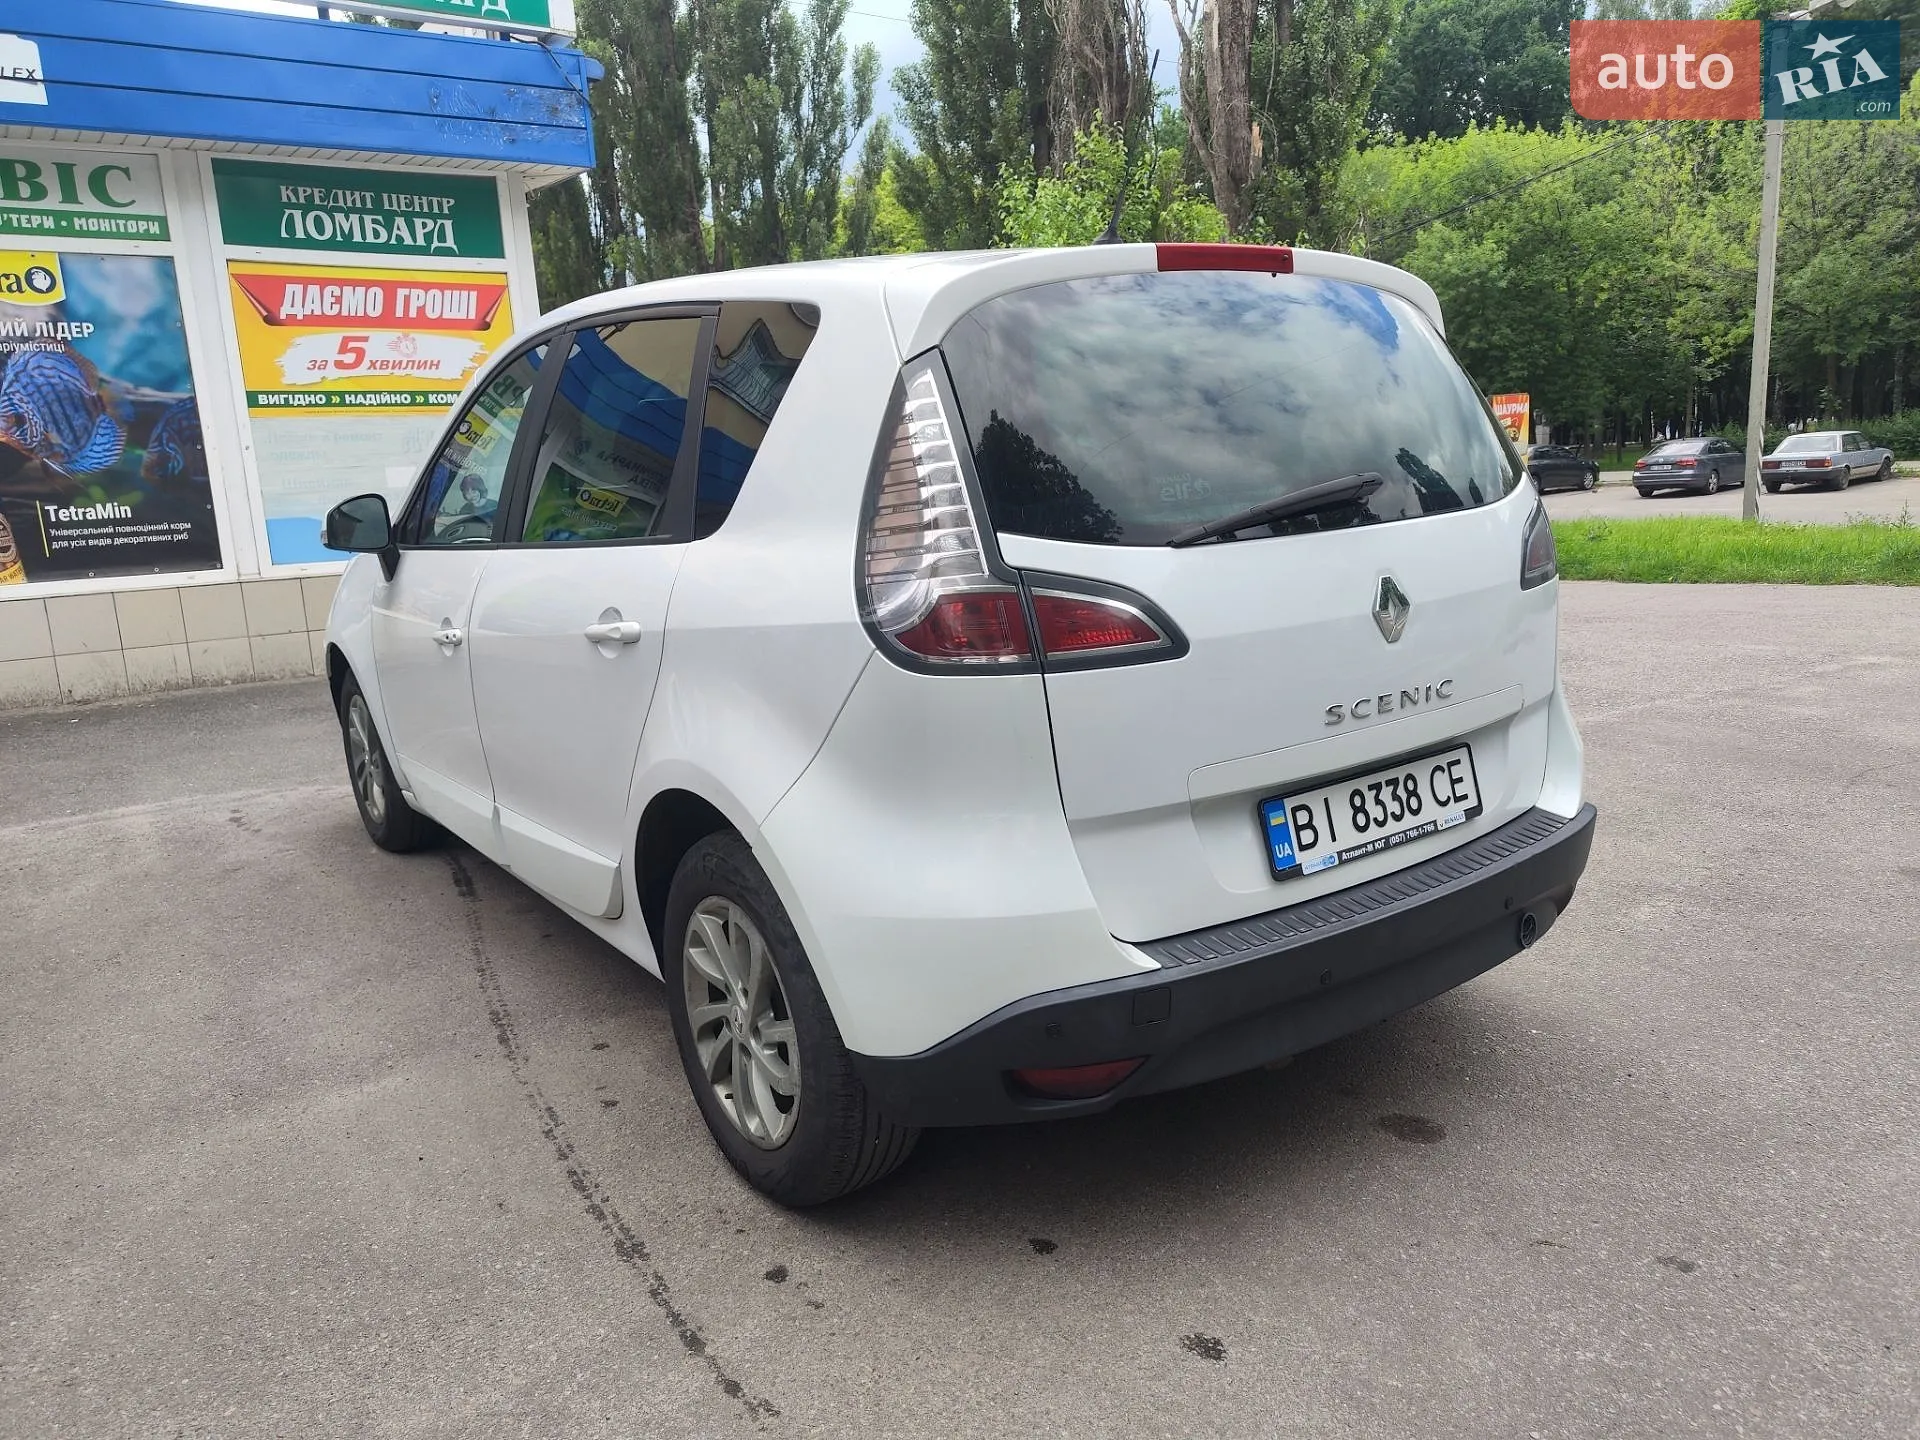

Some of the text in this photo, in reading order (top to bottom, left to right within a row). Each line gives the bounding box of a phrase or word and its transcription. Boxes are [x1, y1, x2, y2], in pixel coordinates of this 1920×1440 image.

[279, 186, 456, 215] КРЕДИТ ЦЕНТР
[0, 213, 160, 234] 'ТЕРИ МОНІТОРИ
[279, 209, 459, 255] ЛОМБАРД
[280, 284, 478, 320] ДАЄМО ГРОШІ
[35, 322, 95, 340] ЛІДЕР
[307, 336, 441, 371] за 5 хвилин
[258, 394, 326, 407] ВИГІДНО
[345, 393, 411, 406] НАДІЙНО
[44, 501, 132, 521] TetraMin
[49, 522, 192, 538] Універсальний повноцінний корм
[52, 531, 189, 549] для усіх видів декоративних риб
[1324, 679, 1454, 725] SCENIC
[1290, 758, 1469, 852] BI 8338 CE
[1389, 833, 1405, 846] (057)
[1275, 843, 1293, 859] UA
